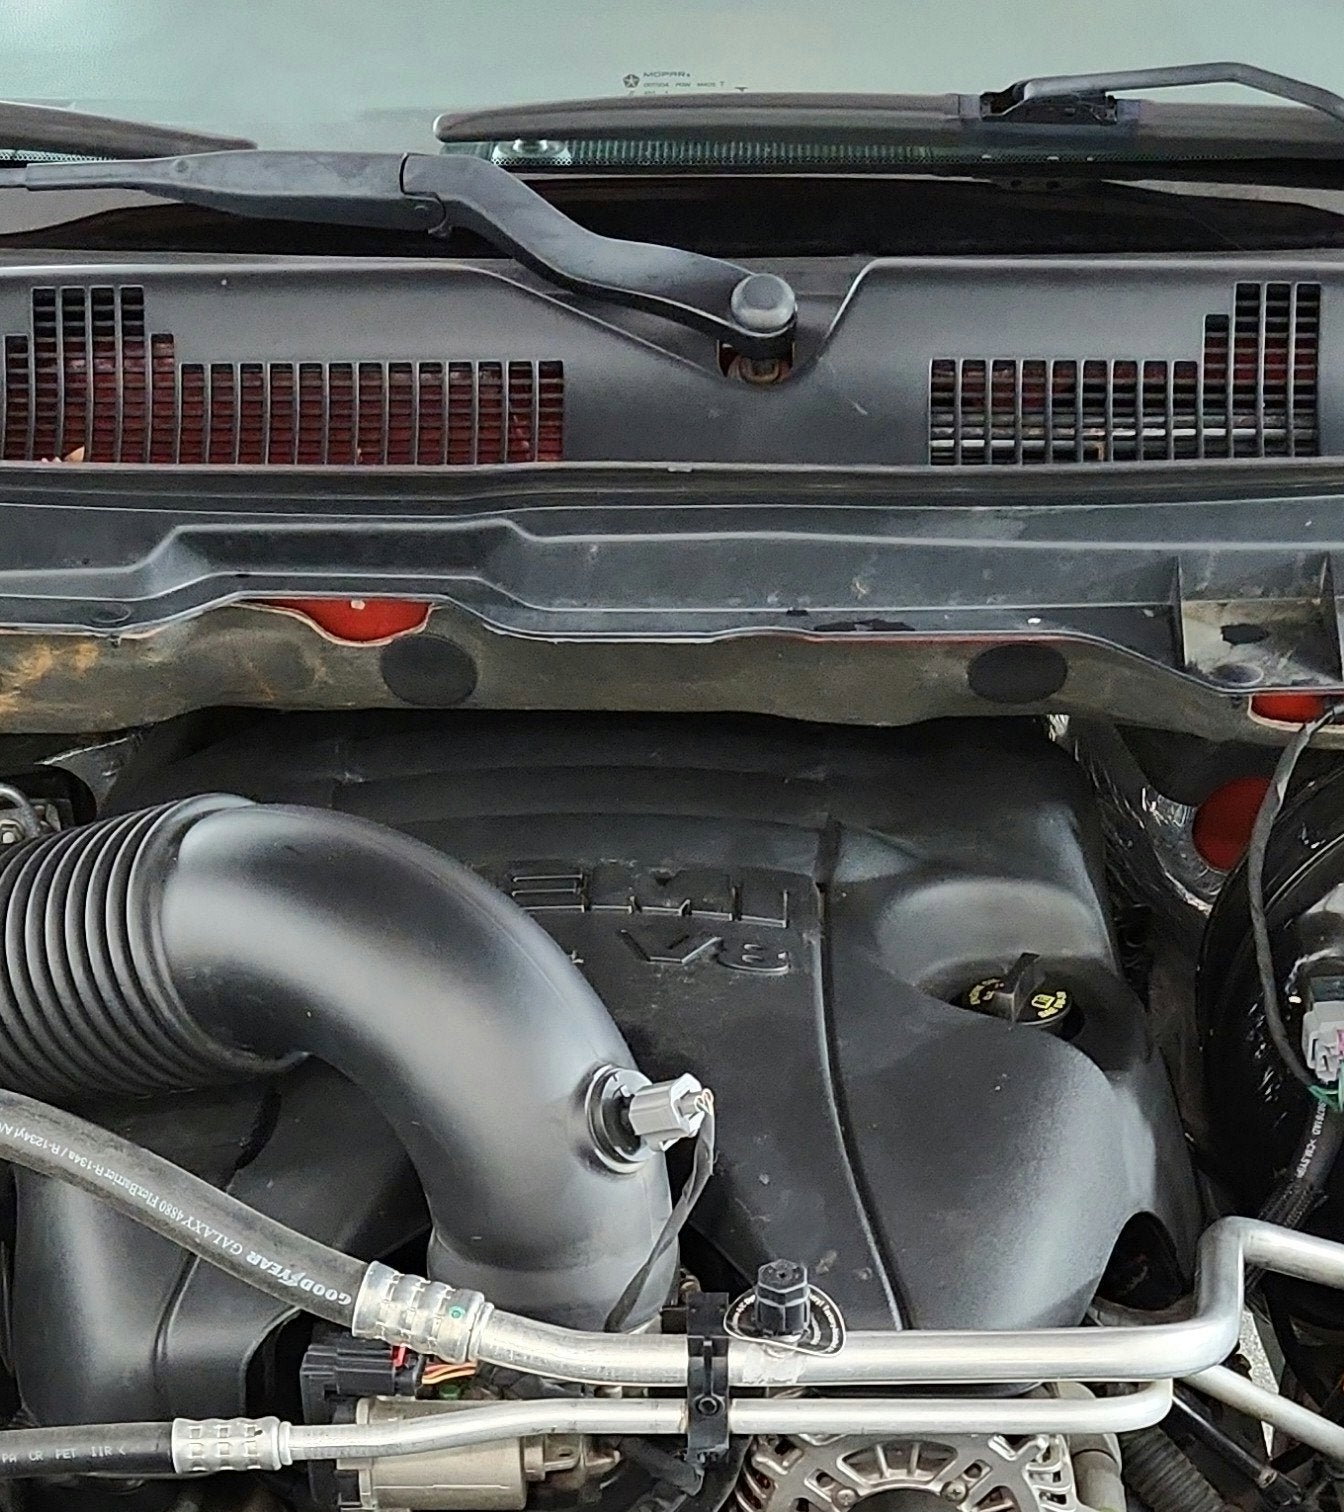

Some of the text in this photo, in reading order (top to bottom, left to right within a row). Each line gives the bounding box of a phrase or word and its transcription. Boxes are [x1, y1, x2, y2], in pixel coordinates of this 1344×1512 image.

[159, 1200, 185, 1221] 4880
[181, 1214, 243, 1255] GALAXY
[246, 1250, 352, 1306] GOODYEAR
